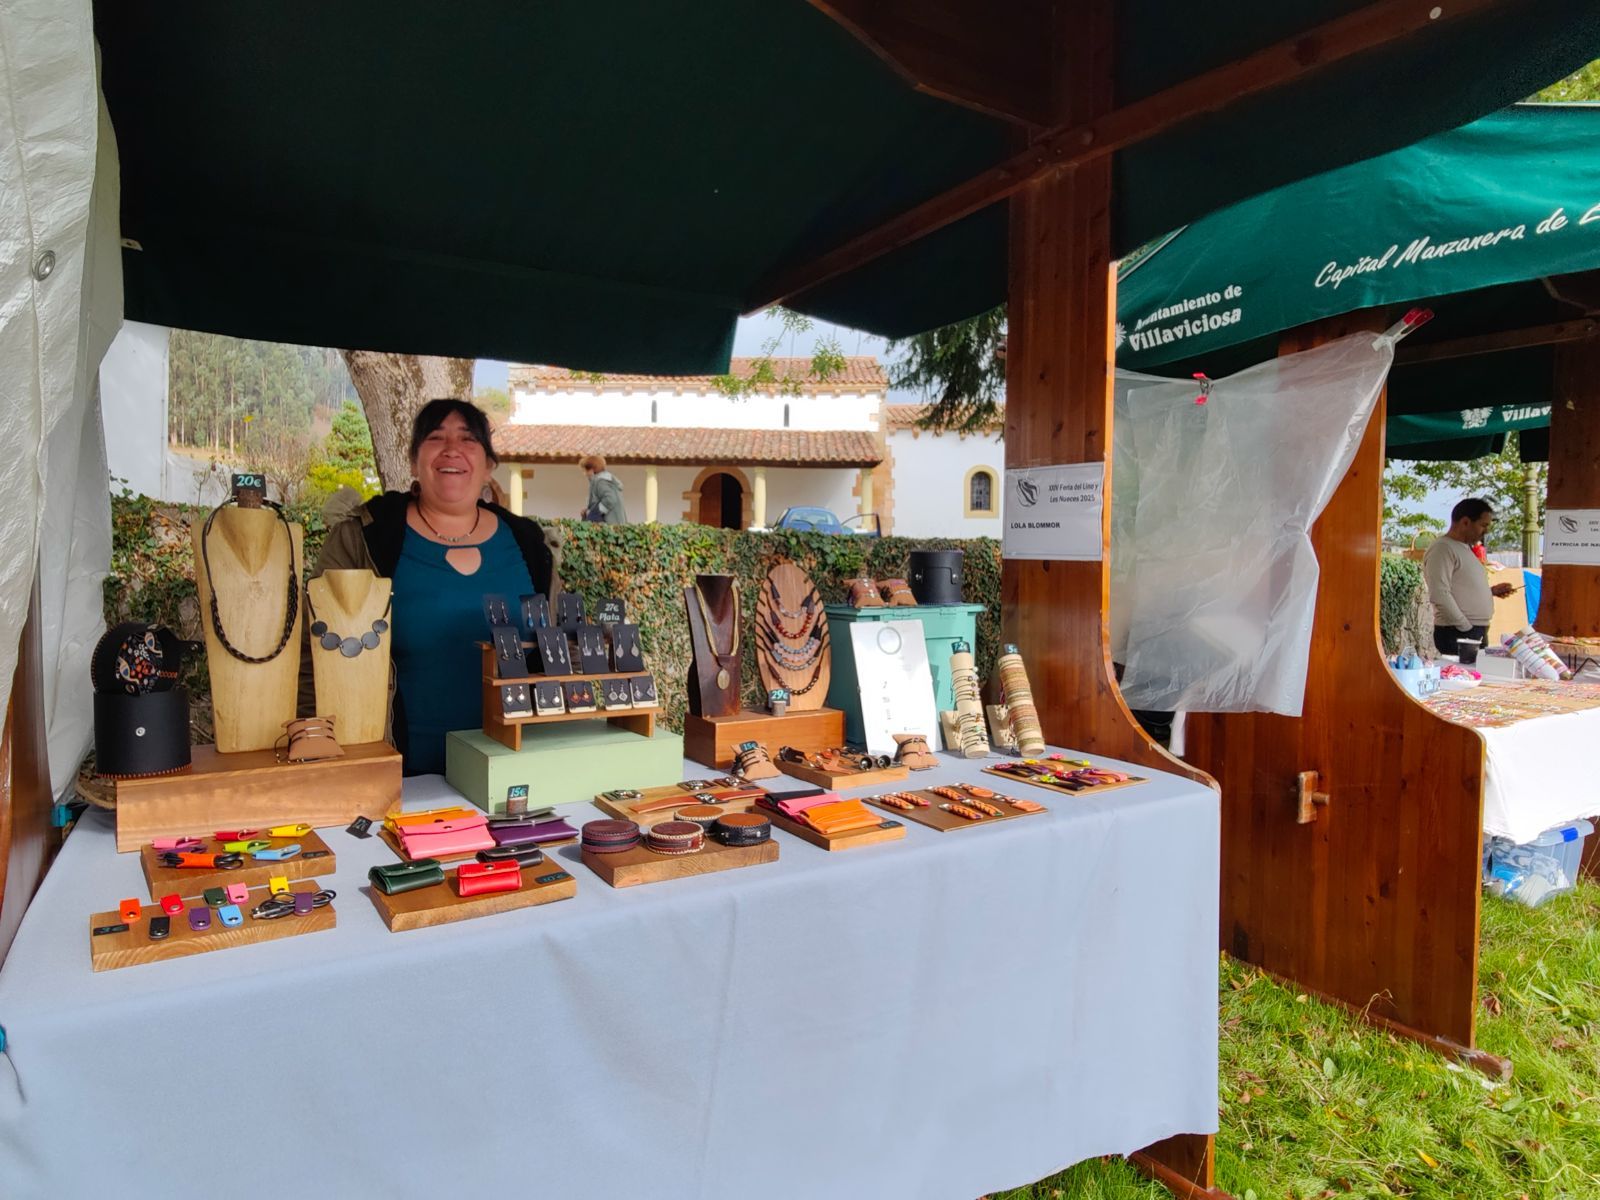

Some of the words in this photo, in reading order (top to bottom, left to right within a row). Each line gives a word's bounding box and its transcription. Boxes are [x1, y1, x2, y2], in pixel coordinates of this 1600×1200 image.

[1314, 245, 1398, 289] Capital
[1393, 224, 1526, 268] Manzanera
[1536, 207, 1568, 235] de
[1224, 284, 1243, 300] de
[1128, 308, 1242, 351] Villaviciosa
[1502, 406, 1552, 422] Villav
[236, 475, 262, 488] 20€
[1074, 483, 1082, 491] del
[1059, 495, 1079, 503] Nueces
[604, 602, 619, 612] 27€
[599, 612, 620, 621] Plata
[771, 689, 788, 700] 29€
[510, 786, 526, 797] 15€
